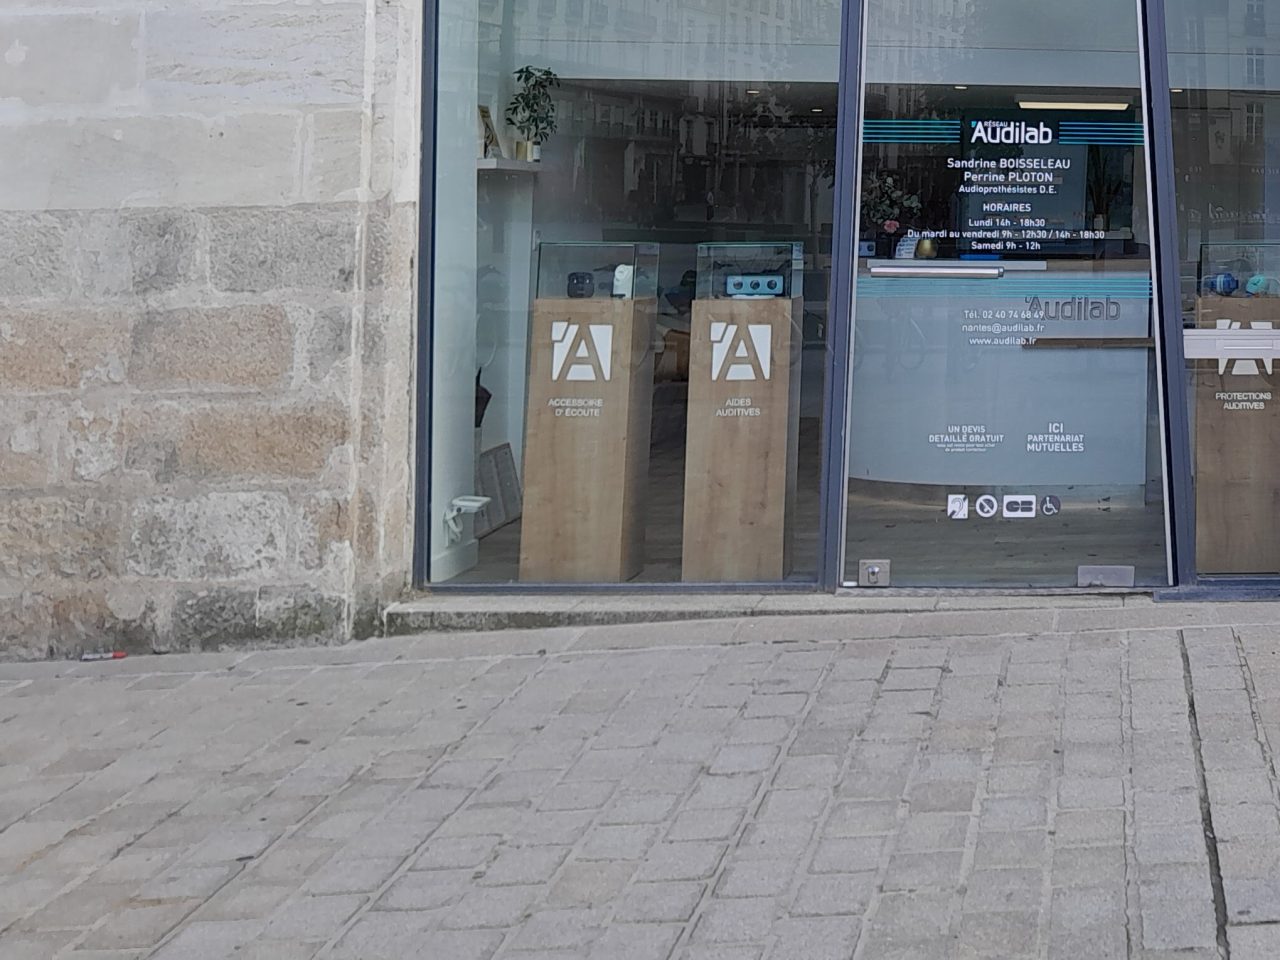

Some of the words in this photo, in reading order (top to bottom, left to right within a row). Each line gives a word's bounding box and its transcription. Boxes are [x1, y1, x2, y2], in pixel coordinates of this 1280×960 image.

[970, 120, 1053, 144] Audilab
[947, 158, 997, 169] Sandrine
[1000, 159, 1071, 169] BOISSELEAU
[964, 172, 1005, 182] Perrine
[1009, 172, 1053, 182] PLOTON
[959, 184, 1037, 195] Audioprothésistes
[1039, 185, 1057, 194] D.E.
[983, 203, 1031, 212] HORAIRES
[968, 219, 993, 227] Lundi
[995, 219, 1011, 227] 14h
[1020, 219, 1046, 227] 18h30
[907, 230, 920, 238] Du
[922, 230, 947, 238] mardi
[962, 230, 1000, 238] vendredi
[1002, 230, 1013, 238] 9h
[1022, 230, 1047, 239] 12h30
[1055, 231, 1071, 239] 14h
[1080, 231, 1105, 239] 18h30
[971, 241, 1004, 250] Samedi
[1006, 241, 1017, 250] 9h
[1026, 241, 1041, 250] 12h
[1024, 295, 1121, 321] Audilab
[982, 311, 993, 319] 02
[995, 311, 1006, 319] 40
[1009, 311, 1019, 319] 74
[962, 323, 1045, 334] nantes@audilab.fr
[969, 337, 1037, 345] www.audilab.fr
[1215, 392, 1272, 401] PROTECTIONS
[725, 397, 752, 406] AIDES
[1223, 401, 1265, 410] AUDITIVES
[716, 407, 761, 416] AUDITIVES
[948, 425, 960, 434] UN
[961, 425, 986, 434] DEVIS
[1049, 423, 1064, 433] ICI
[969, 434, 1005, 443] GRATUIT
[1027, 434, 1084, 443] PARTENARIAT
[1027, 443, 1085, 452] MUTUELLES
